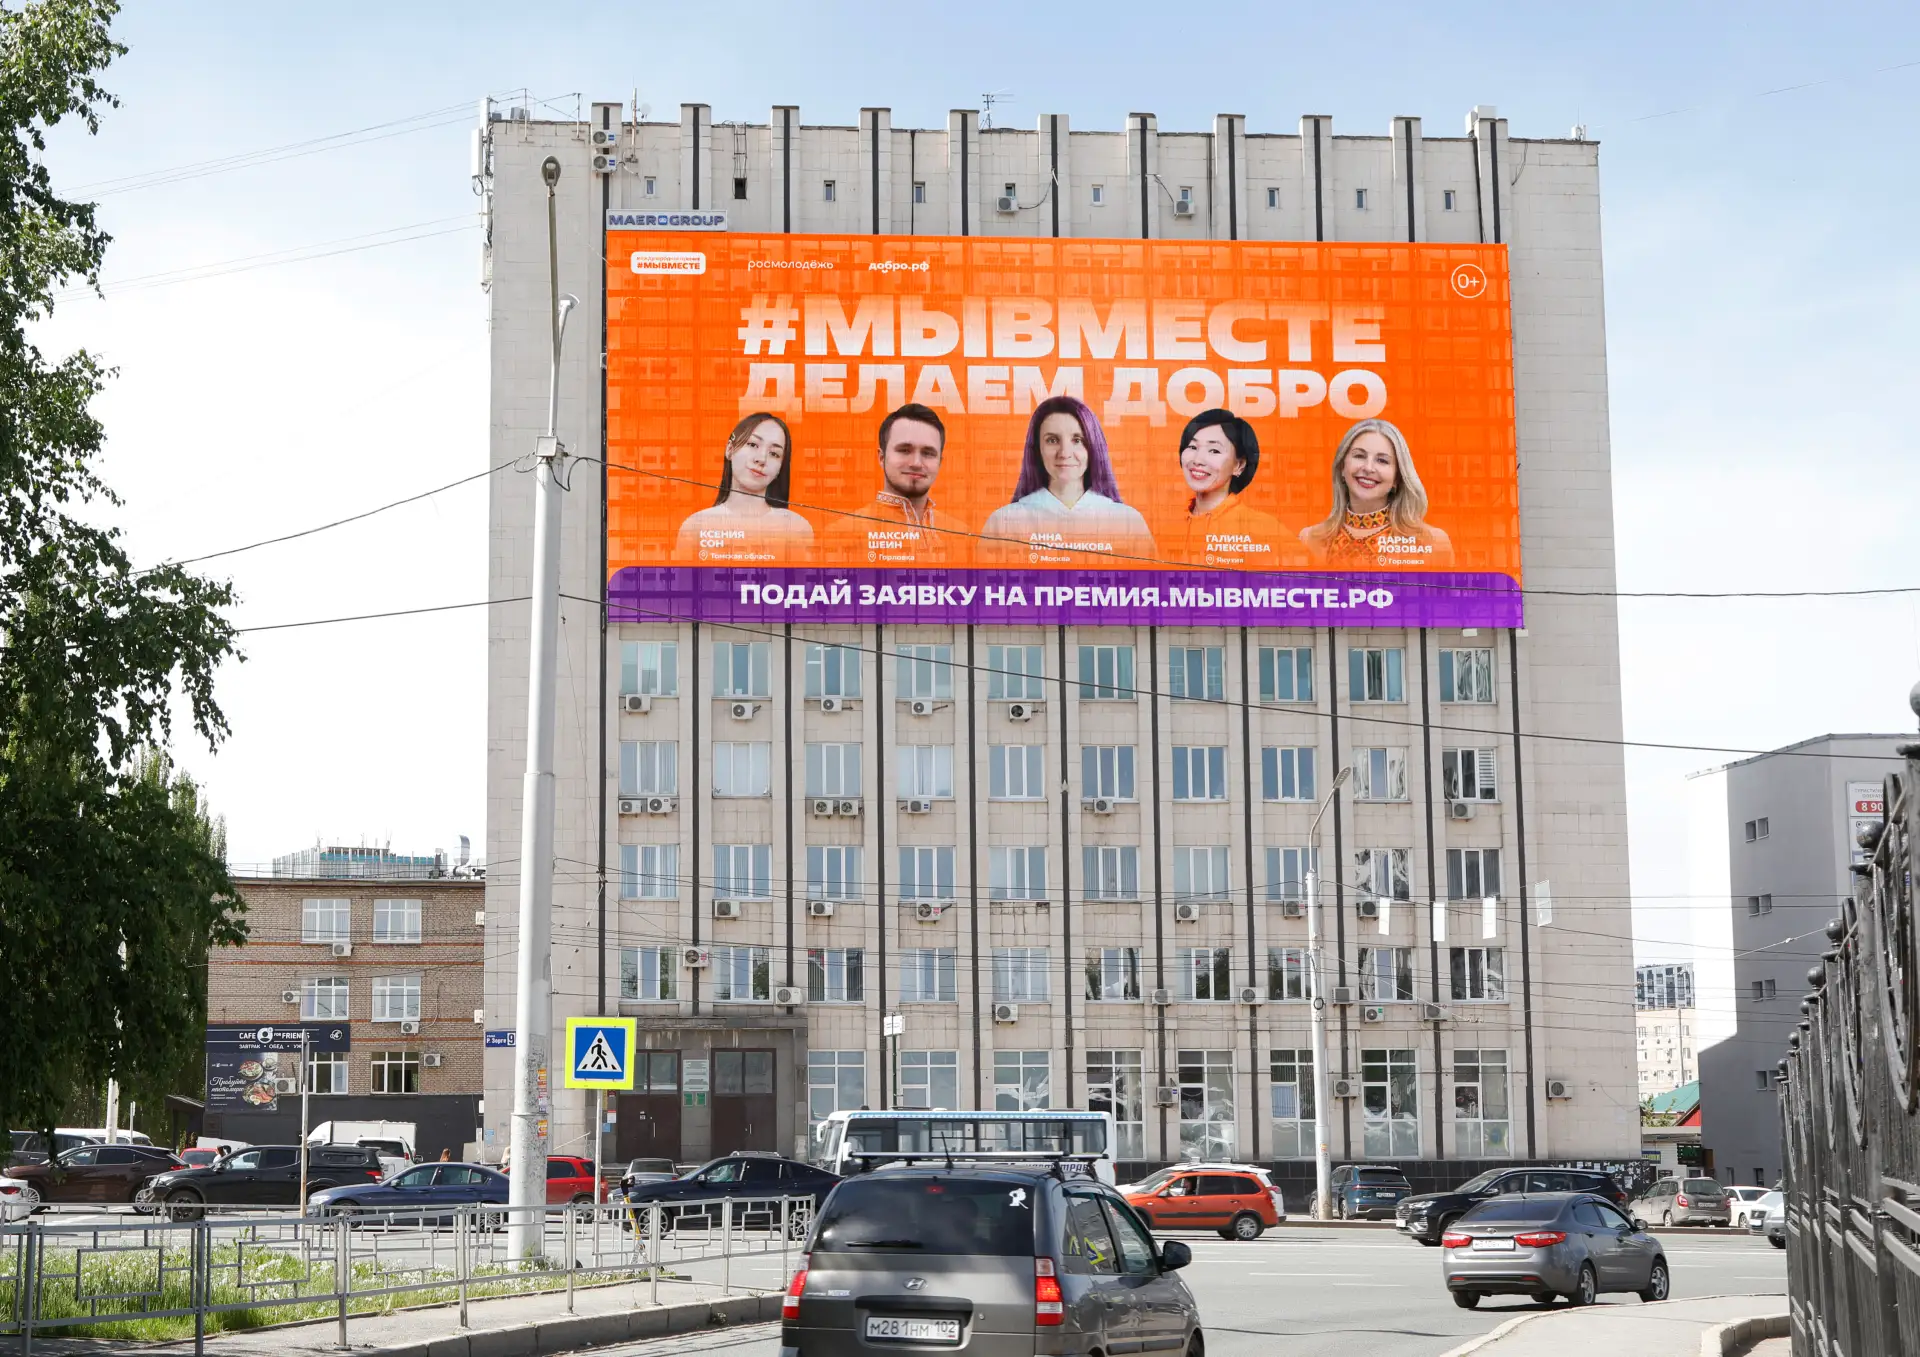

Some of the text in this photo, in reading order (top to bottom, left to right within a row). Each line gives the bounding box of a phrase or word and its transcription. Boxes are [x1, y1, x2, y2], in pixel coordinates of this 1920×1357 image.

[669, 215, 725, 226] GROUP
[637, 262, 701, 270] #МЫВМЕСТЕ
[748, 259, 834, 272] росмолодёжь
[868, 260, 930, 274] добро.рф
[1457, 272, 1481, 290] 0+
[737, 293, 1387, 363] #МЫВМЕСТЕ
[737, 362, 1388, 427] ДЕЛАЕМ ДОБРО
[699, 530, 745, 539] КСЕНИЯ
[868, 531, 920, 540] МАКСИМ
[1029, 533, 1063, 541] АННА
[1205, 534, 1252, 543] ГАЛИНА
[699, 539, 725, 548] СОН
[1377, 536, 1417, 545] ДАРЬЯ
[1206, 543, 1271, 552] АЛЕКСЕЕВА
[1377, 545, 1433, 554] ЛОЗОВАЯ
[711, 552, 776, 561] Томская область
[878, 553, 915, 562] Горловка
[1388, 558, 1425, 566] Горловка
[740, 578, 1394, 609] ПОДАЙ ЗАЯВКУ НА ПРЕМИЯ.МЫВМЕСТЕ.РФ
[1862, 802, 1884, 812] 8 90
[508, 1034, 514, 1044] 9
[869, 1319, 956, 1336] М281НМ 102
